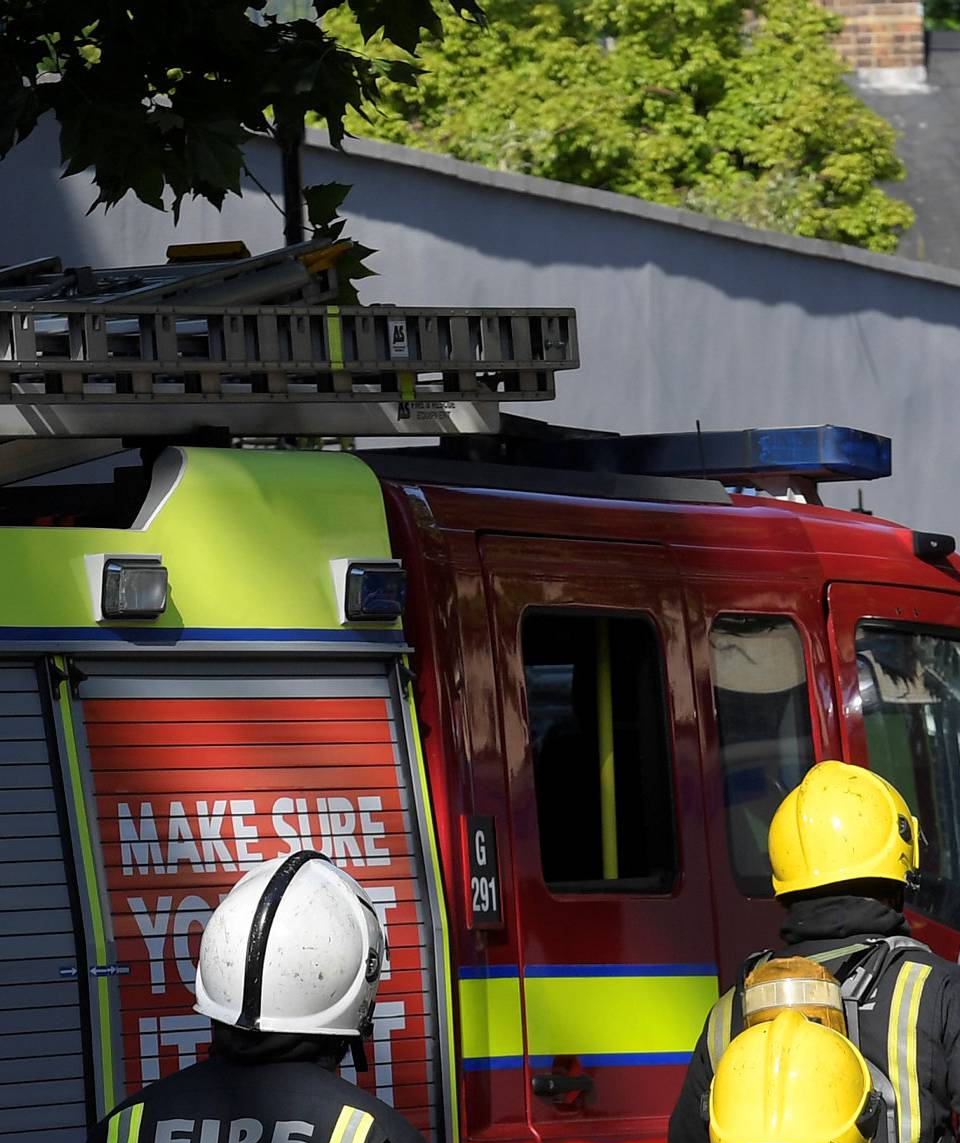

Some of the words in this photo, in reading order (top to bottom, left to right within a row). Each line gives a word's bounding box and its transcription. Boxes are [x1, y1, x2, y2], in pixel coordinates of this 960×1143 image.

[117, 799, 264, 876] MAKE
[272, 795, 391, 867] SURE
[475, 829, 487, 866] G
[471, 876, 497, 912] 291
